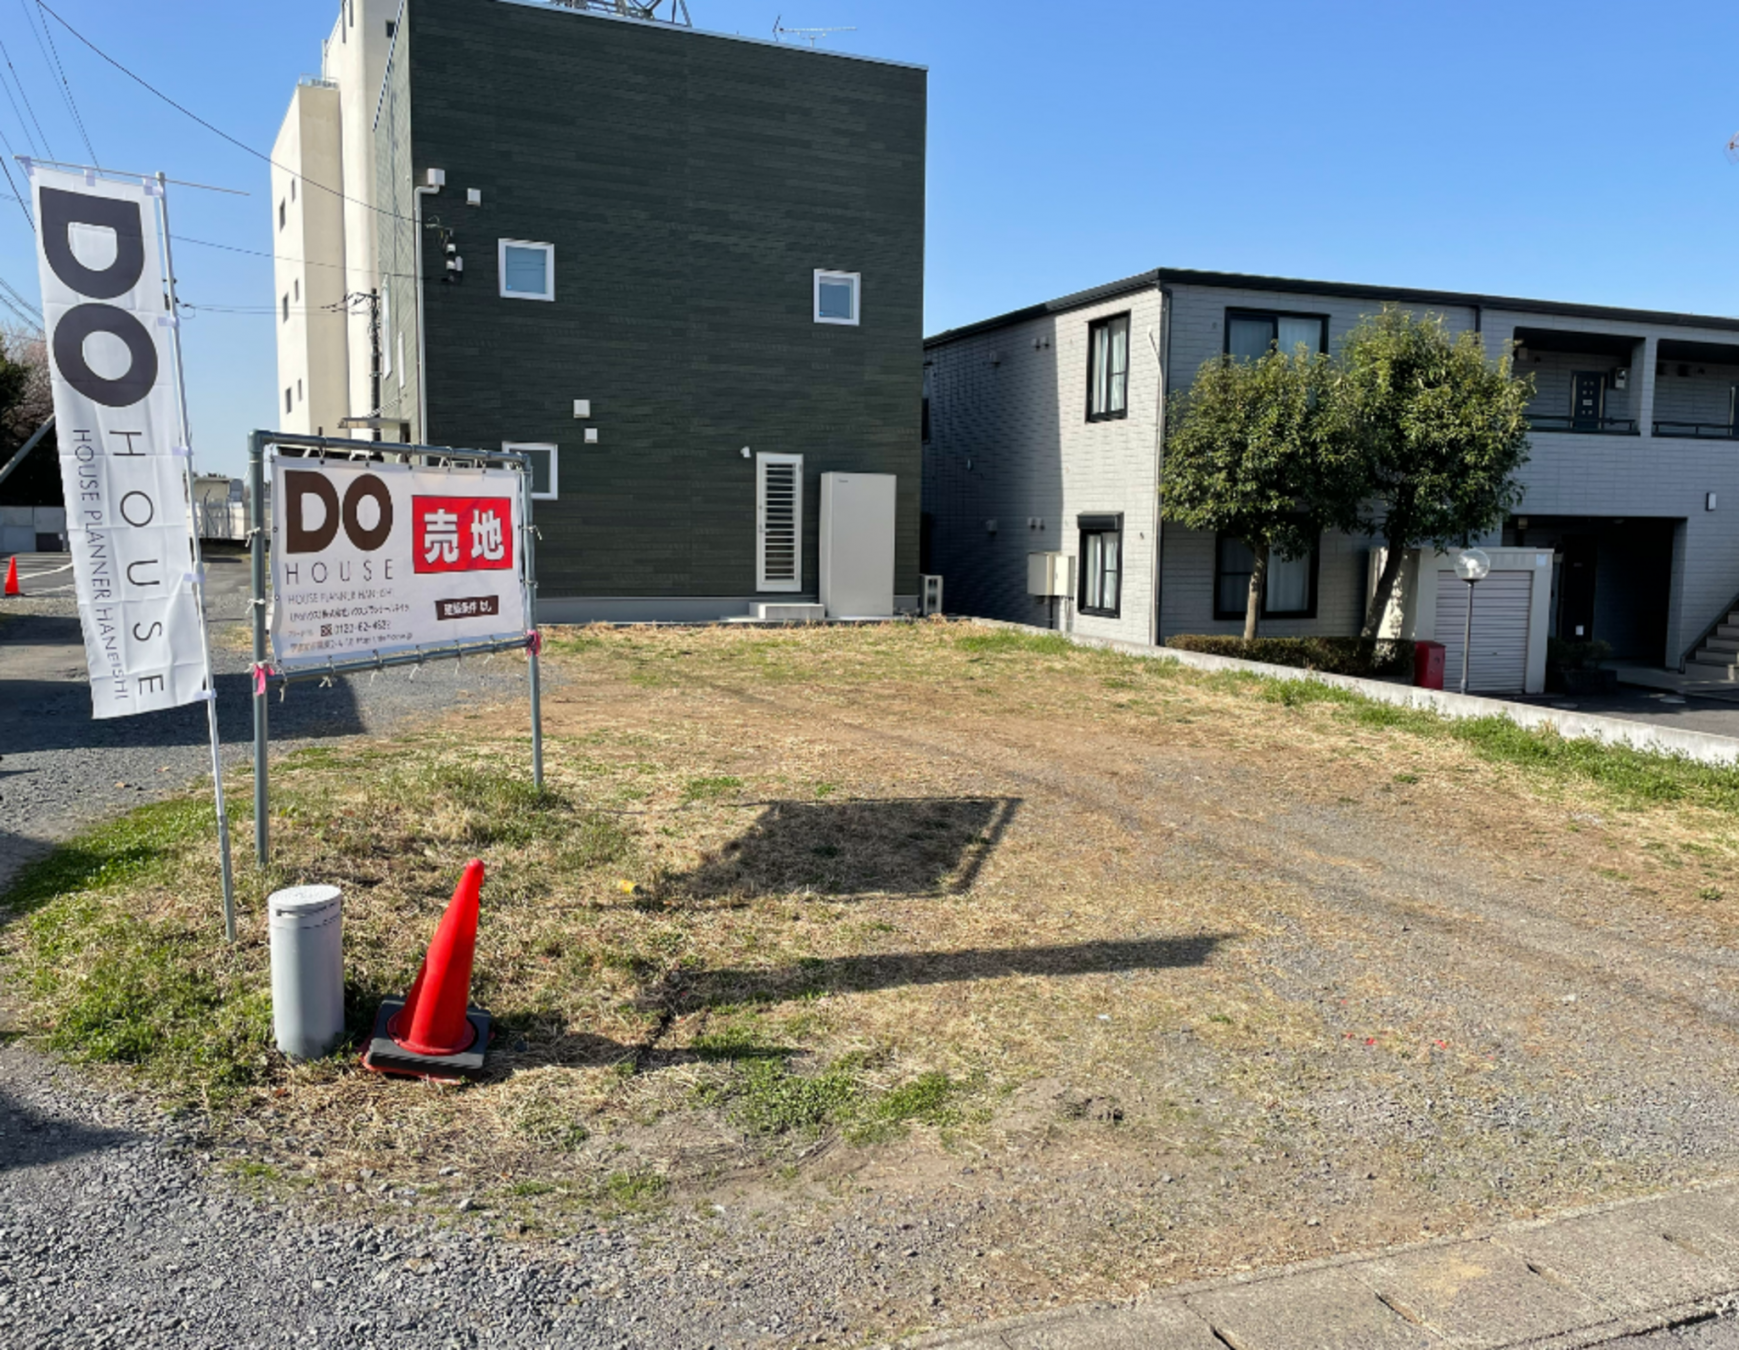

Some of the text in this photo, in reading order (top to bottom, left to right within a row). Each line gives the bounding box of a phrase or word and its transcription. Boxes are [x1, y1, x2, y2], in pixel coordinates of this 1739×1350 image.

[39, 186, 159, 408] DO
[73, 429, 130, 701] HOUSE PLANNER HANEISHI
[109, 430, 164, 696] HOUSE
[284, 469, 394, 555] DO
[285, 558, 394, 586] HOUSE
[423, 508, 505, 564] 売地
